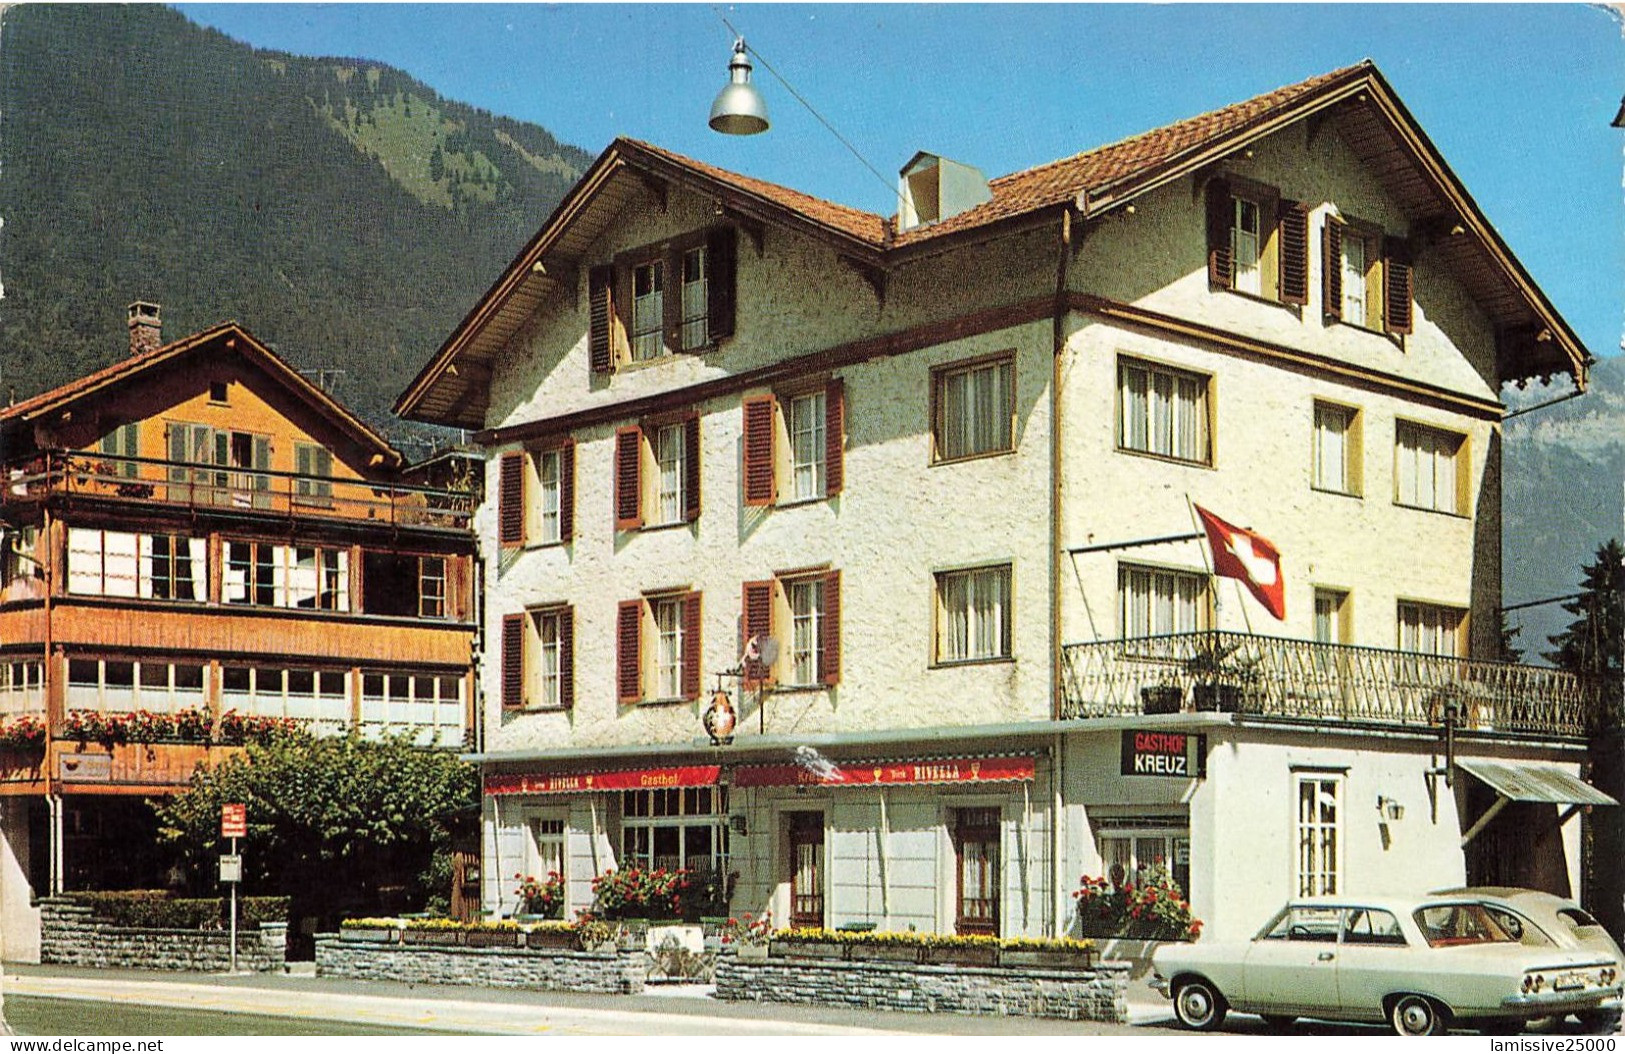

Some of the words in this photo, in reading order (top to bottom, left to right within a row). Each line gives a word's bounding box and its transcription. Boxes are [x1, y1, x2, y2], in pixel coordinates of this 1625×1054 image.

[1135, 732, 1185, 752] GASTHOF
[1135, 753, 1186, 774] KREUZ
[641, 772, 678, 786] Gasthof
[914, 765, 960, 780] RIVELLA
